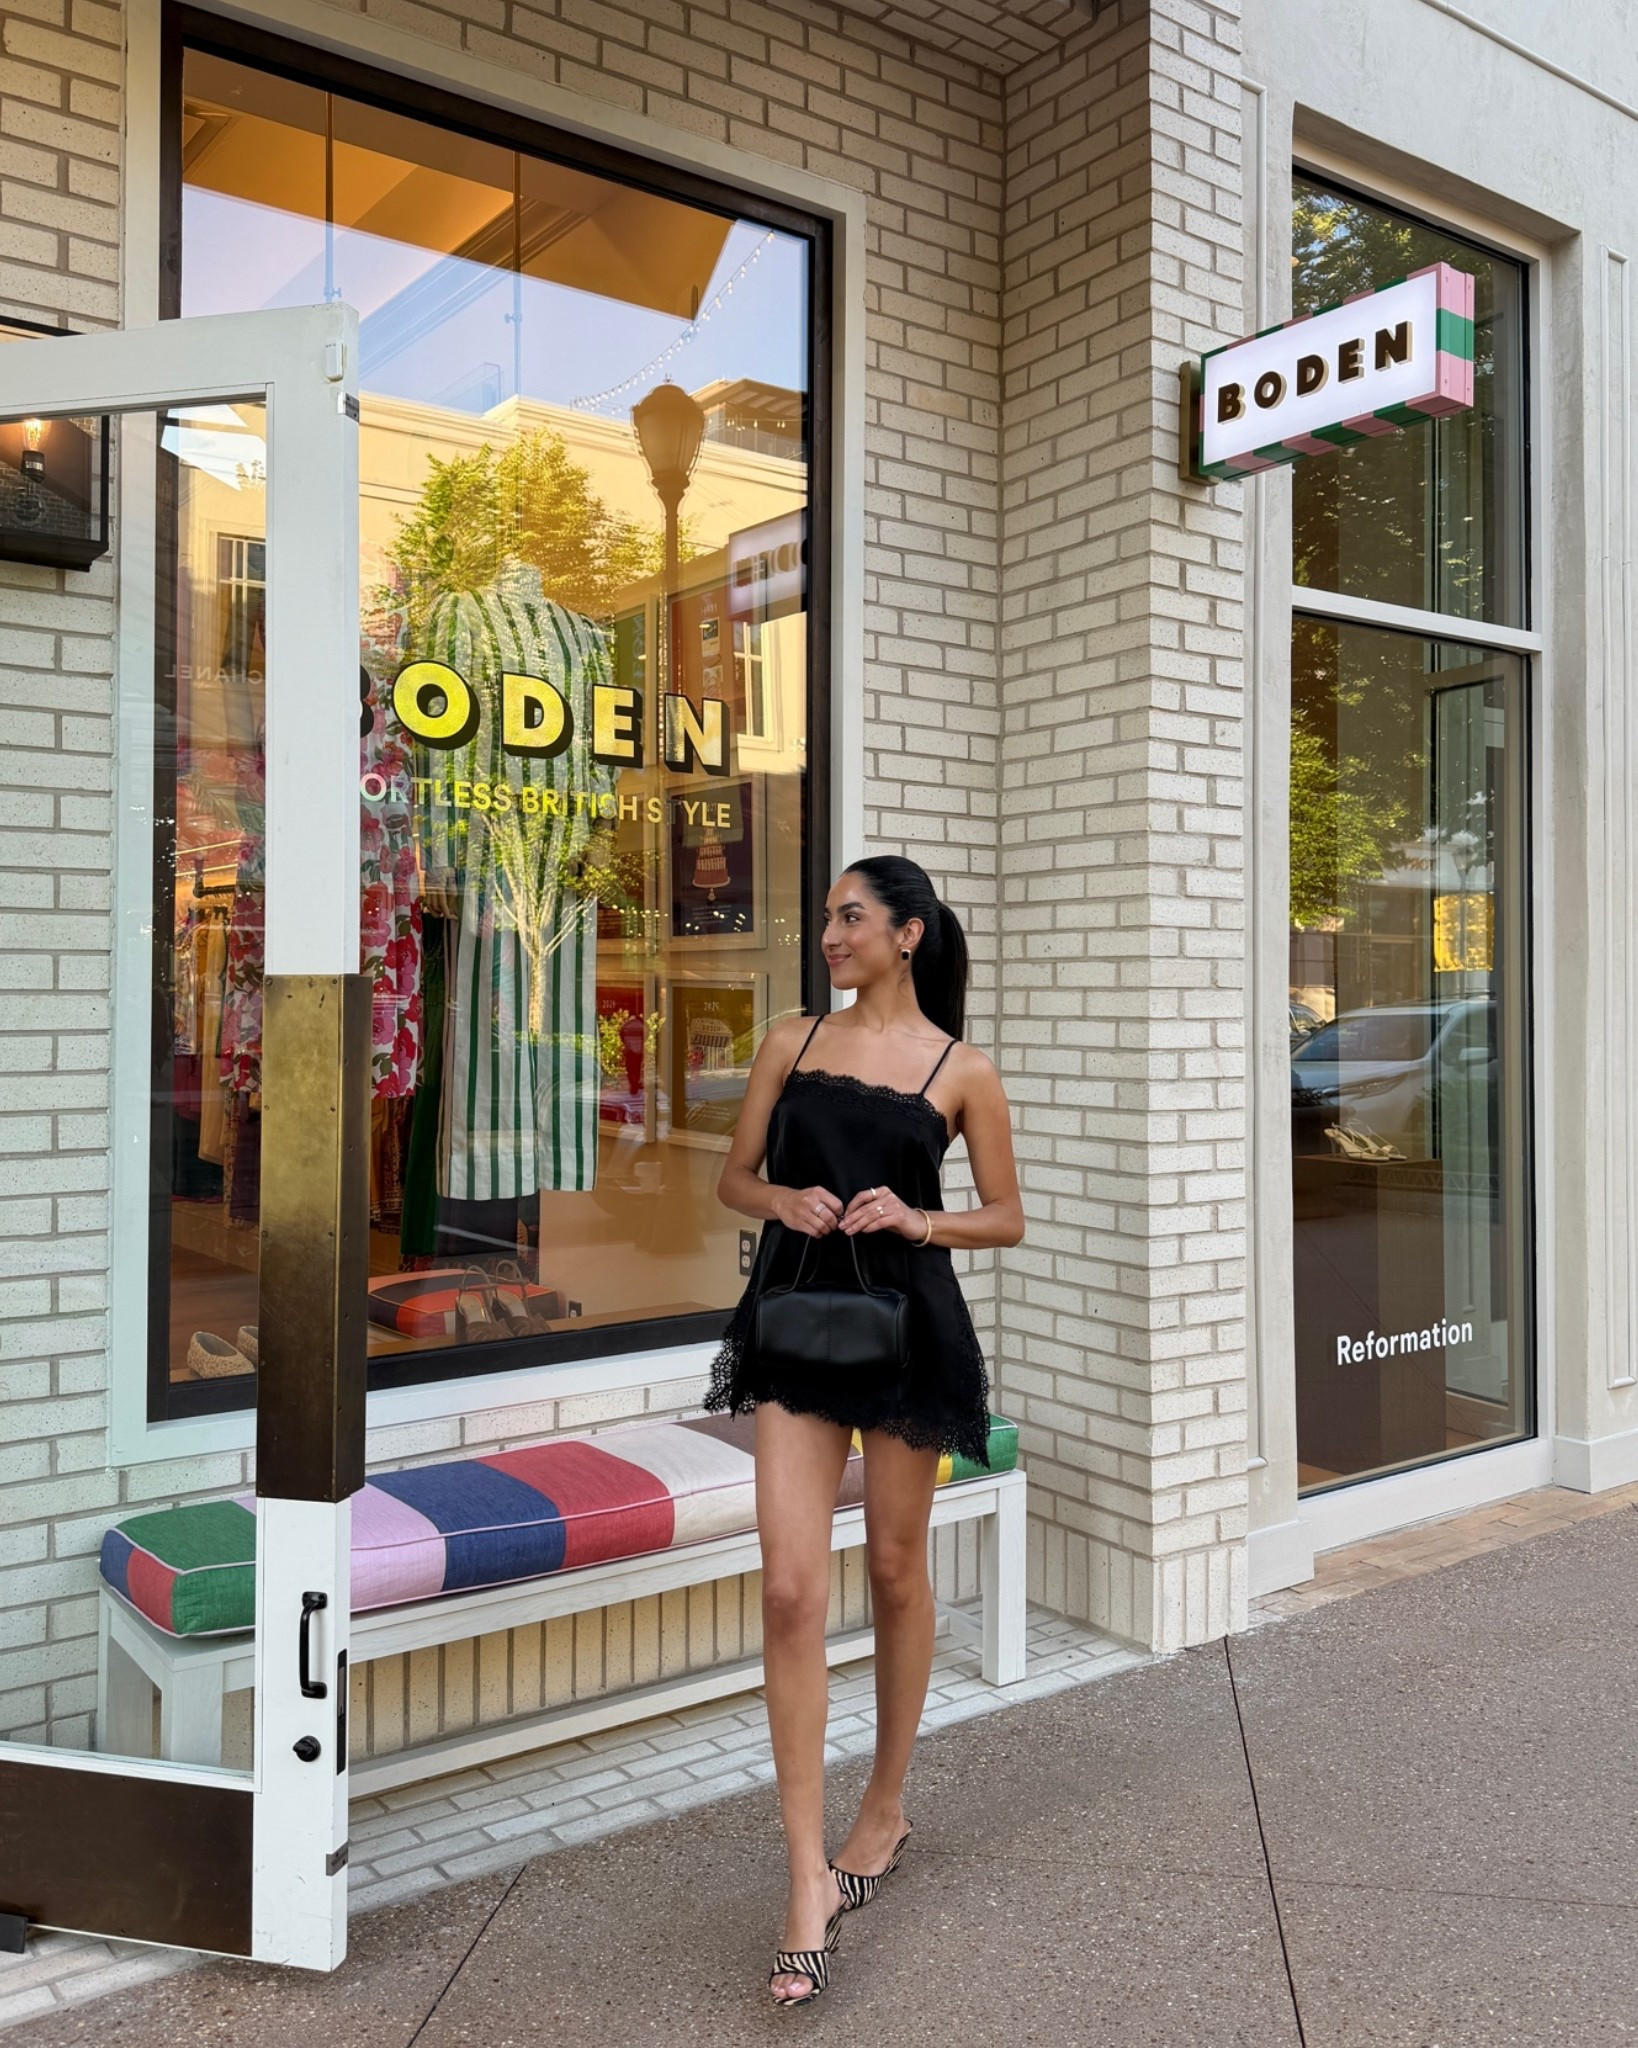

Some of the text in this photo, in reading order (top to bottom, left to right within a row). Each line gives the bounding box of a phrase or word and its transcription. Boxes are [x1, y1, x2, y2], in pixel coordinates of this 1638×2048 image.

[1217, 320, 1412, 424] BODEN
[360, 660, 731, 777] ODEN
[360, 773, 512, 812] ORTLESS
[522, 787, 637, 821] BRITISH
[1337, 1318, 1473, 1366] Reformation
